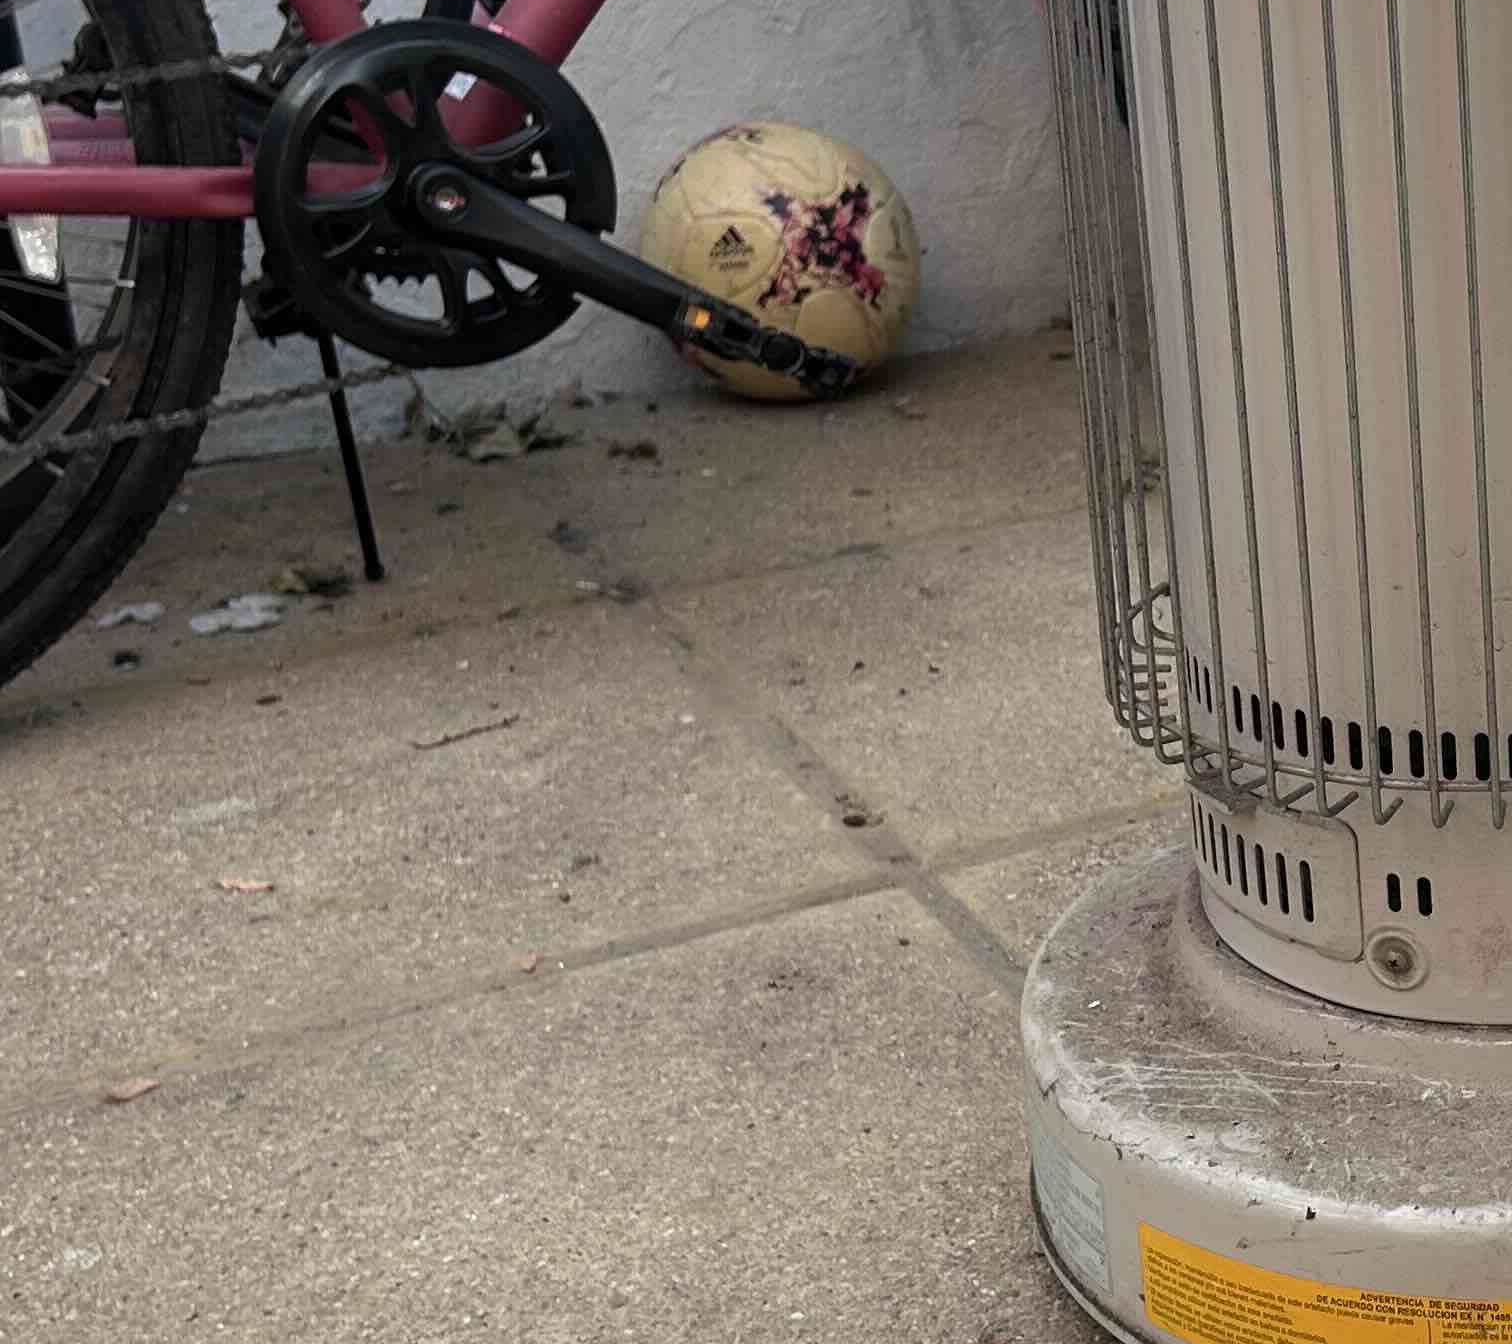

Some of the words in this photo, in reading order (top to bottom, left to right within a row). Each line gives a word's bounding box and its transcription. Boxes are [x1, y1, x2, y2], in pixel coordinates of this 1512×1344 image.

[1316, 1294, 1328, 1305] DE
[1330, 1299, 1374, 1312] ACUERDO
[1375, 1304, 1395, 1315] CON
[1359, 1293, 1424, 1308] ADVERTENCIA
[1429, 1300, 1442, 1309] DE
[1444, 1302, 1500, 1312] SEGURIDAD
